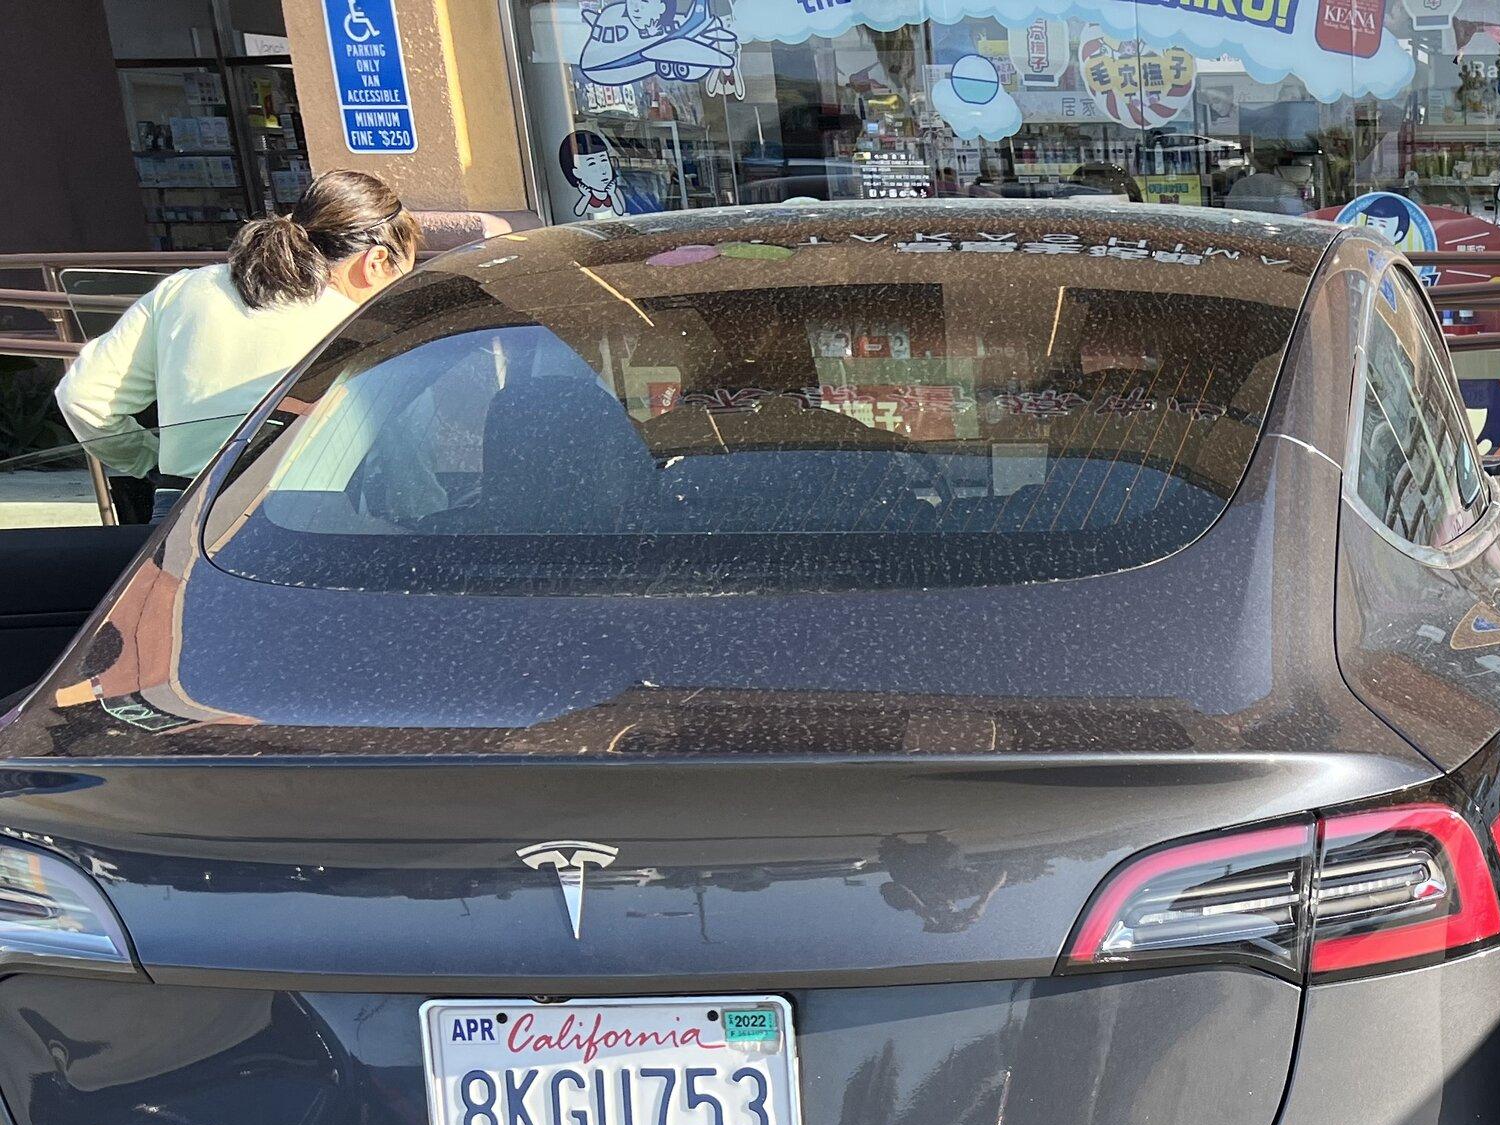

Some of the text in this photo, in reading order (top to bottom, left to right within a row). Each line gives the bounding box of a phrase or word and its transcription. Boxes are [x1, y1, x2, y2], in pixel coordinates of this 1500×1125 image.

[346, 43, 386, 57] PARKING
[356, 59, 380, 73] ONLY
[362, 75, 381, 87] VAN
[347, 89, 400, 102] ACCESSIBLE
[355, 112, 400, 128] MINIMUM
[351, 131, 410, 146] FINE $250
[452, 1017, 495, 1042] APR
[507, 1012, 726, 1064] California
[734, 1014, 766, 1028] 2022
